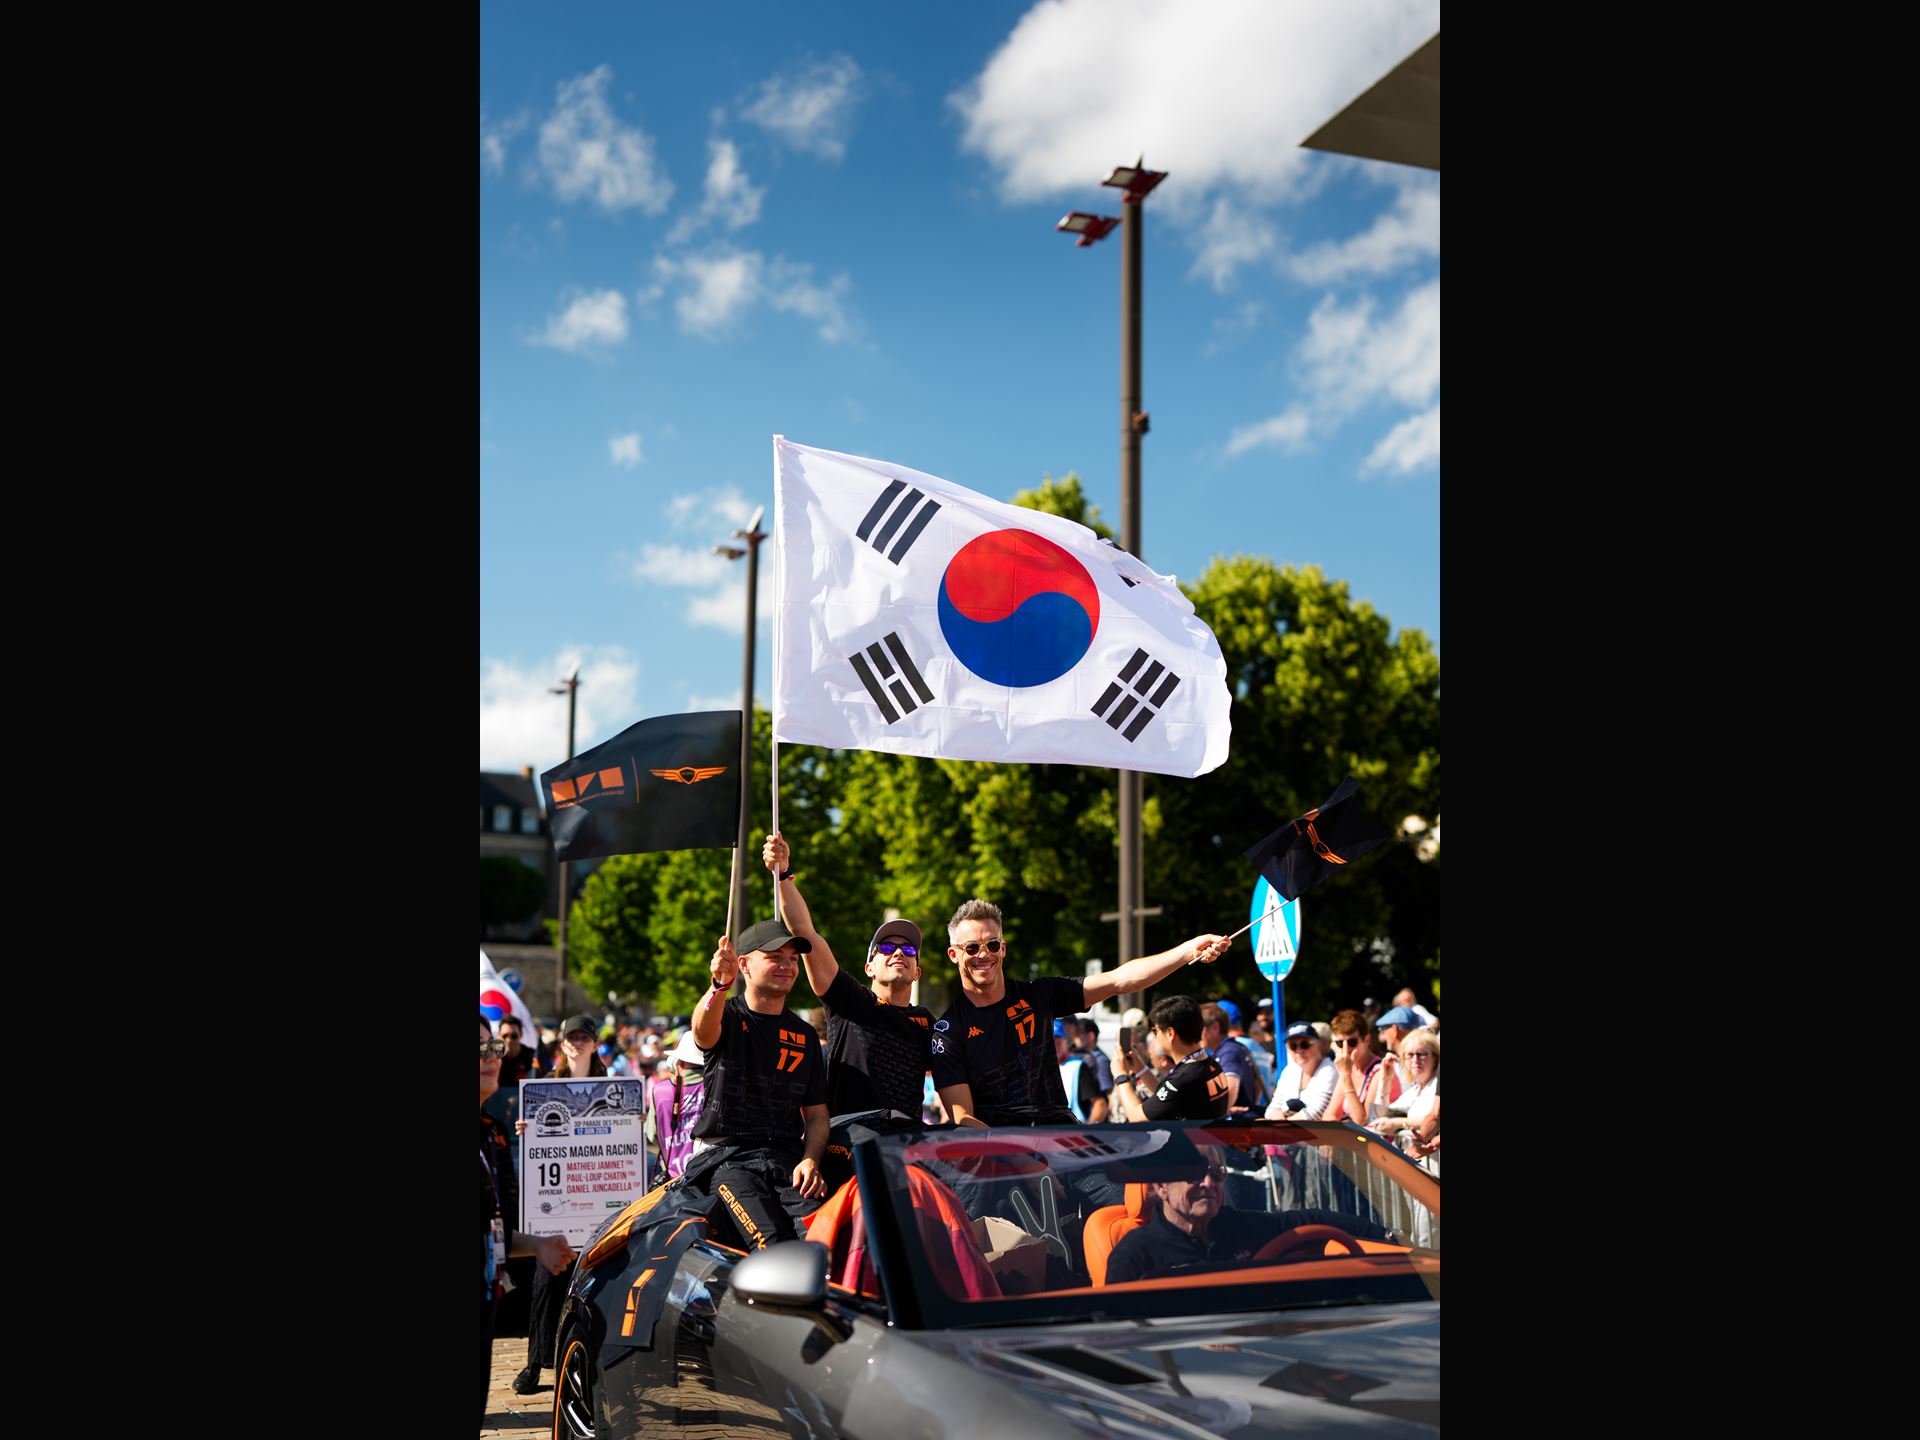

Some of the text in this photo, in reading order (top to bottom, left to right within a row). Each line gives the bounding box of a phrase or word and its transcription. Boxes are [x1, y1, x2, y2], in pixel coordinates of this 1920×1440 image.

[1015, 1012, 1035, 1045] 17
[777, 1047, 804, 1073] 17
[529, 1143, 638, 1160] GENESIS MAGMA RACING
[538, 1162, 560, 1187] 19
[566, 1161, 595, 1171] MATHIEU
[597, 1160, 624, 1170] JAMINET
[566, 1172, 602, 1183] PAUL-LOUP
[603, 1171, 627, 1181] CHATIN
[566, 1184, 590, 1194] DANIEL
[592, 1182, 632, 1192] JUNCADELLA
[718, 1183, 758, 1234] GENESIS
